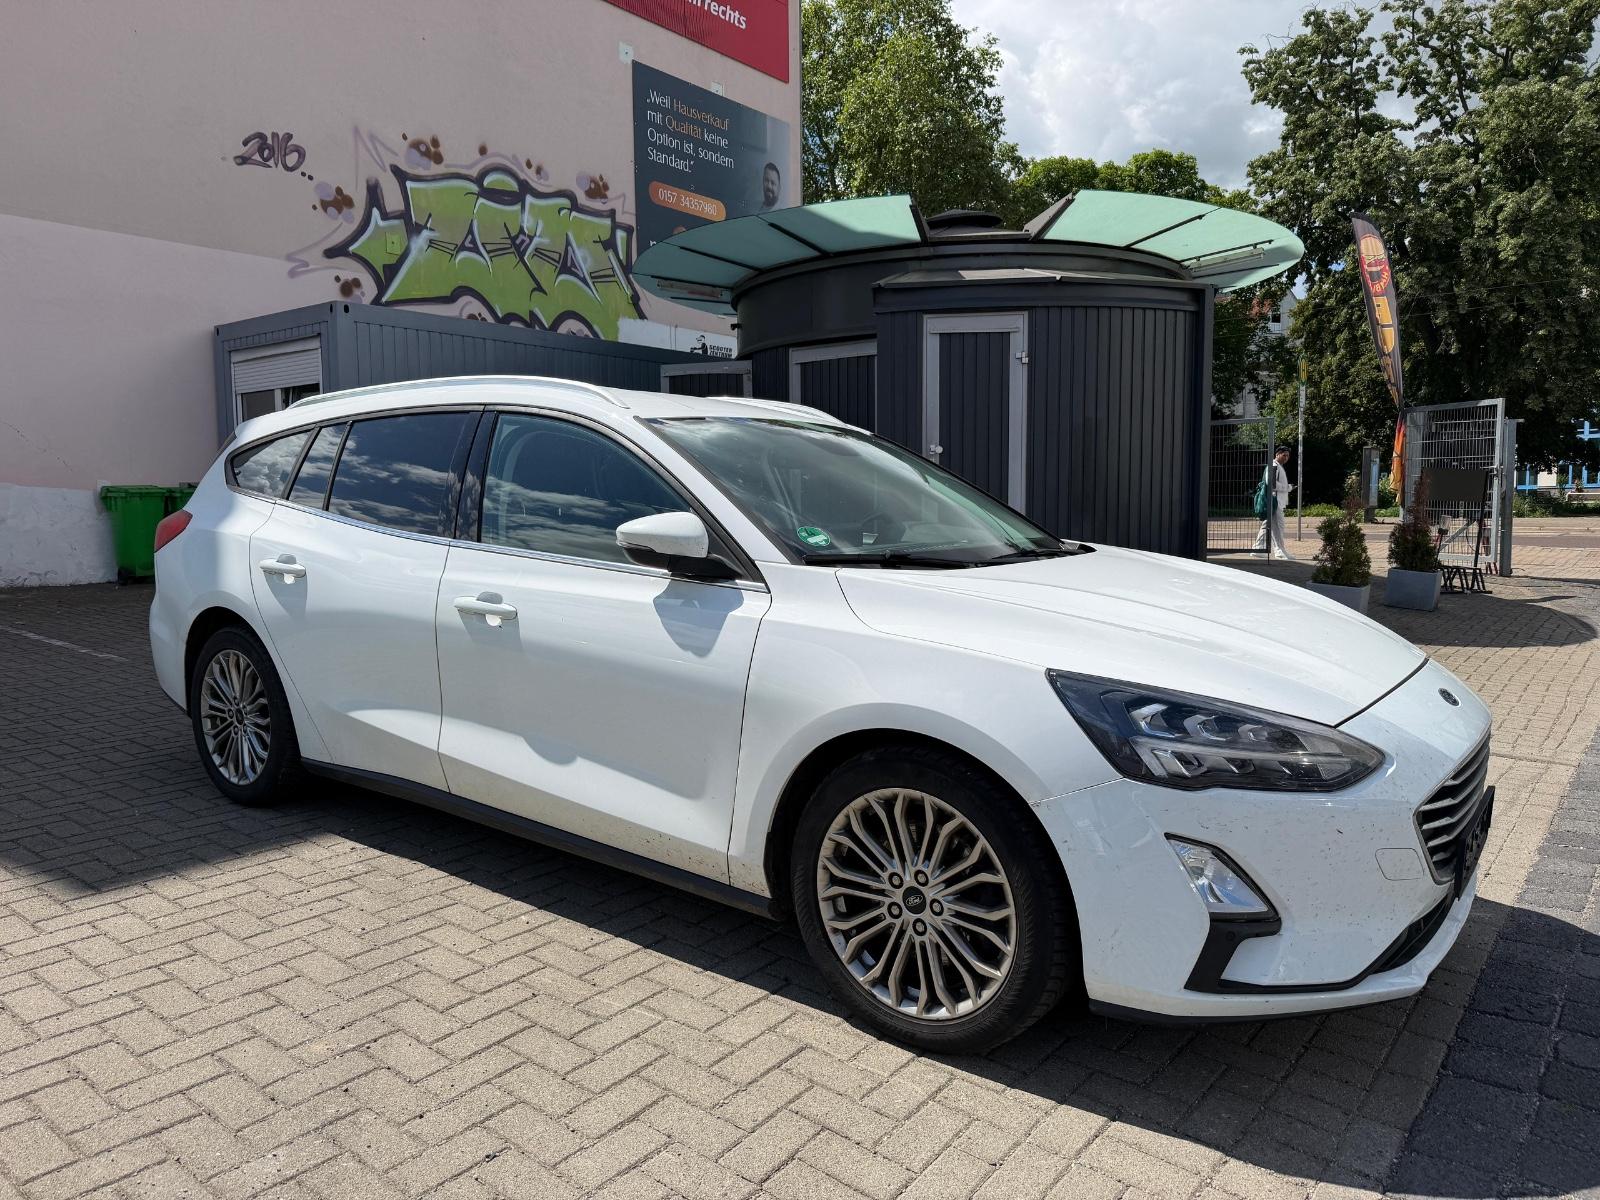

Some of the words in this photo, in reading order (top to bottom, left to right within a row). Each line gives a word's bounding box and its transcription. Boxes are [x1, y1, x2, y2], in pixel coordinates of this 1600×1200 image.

[647, 110, 663, 126] mit
[665, 115, 702, 140] Qualität
[704, 128, 729, 149] keine
[673, 99, 729, 131] Hausverkauf
[647, 127, 681, 151] Option
[683, 140, 696, 157] ist,
[698, 147, 735, 169] sondern
[658, 188, 678, 204] 0157
[709, 345, 733, 353] SCOOTER
